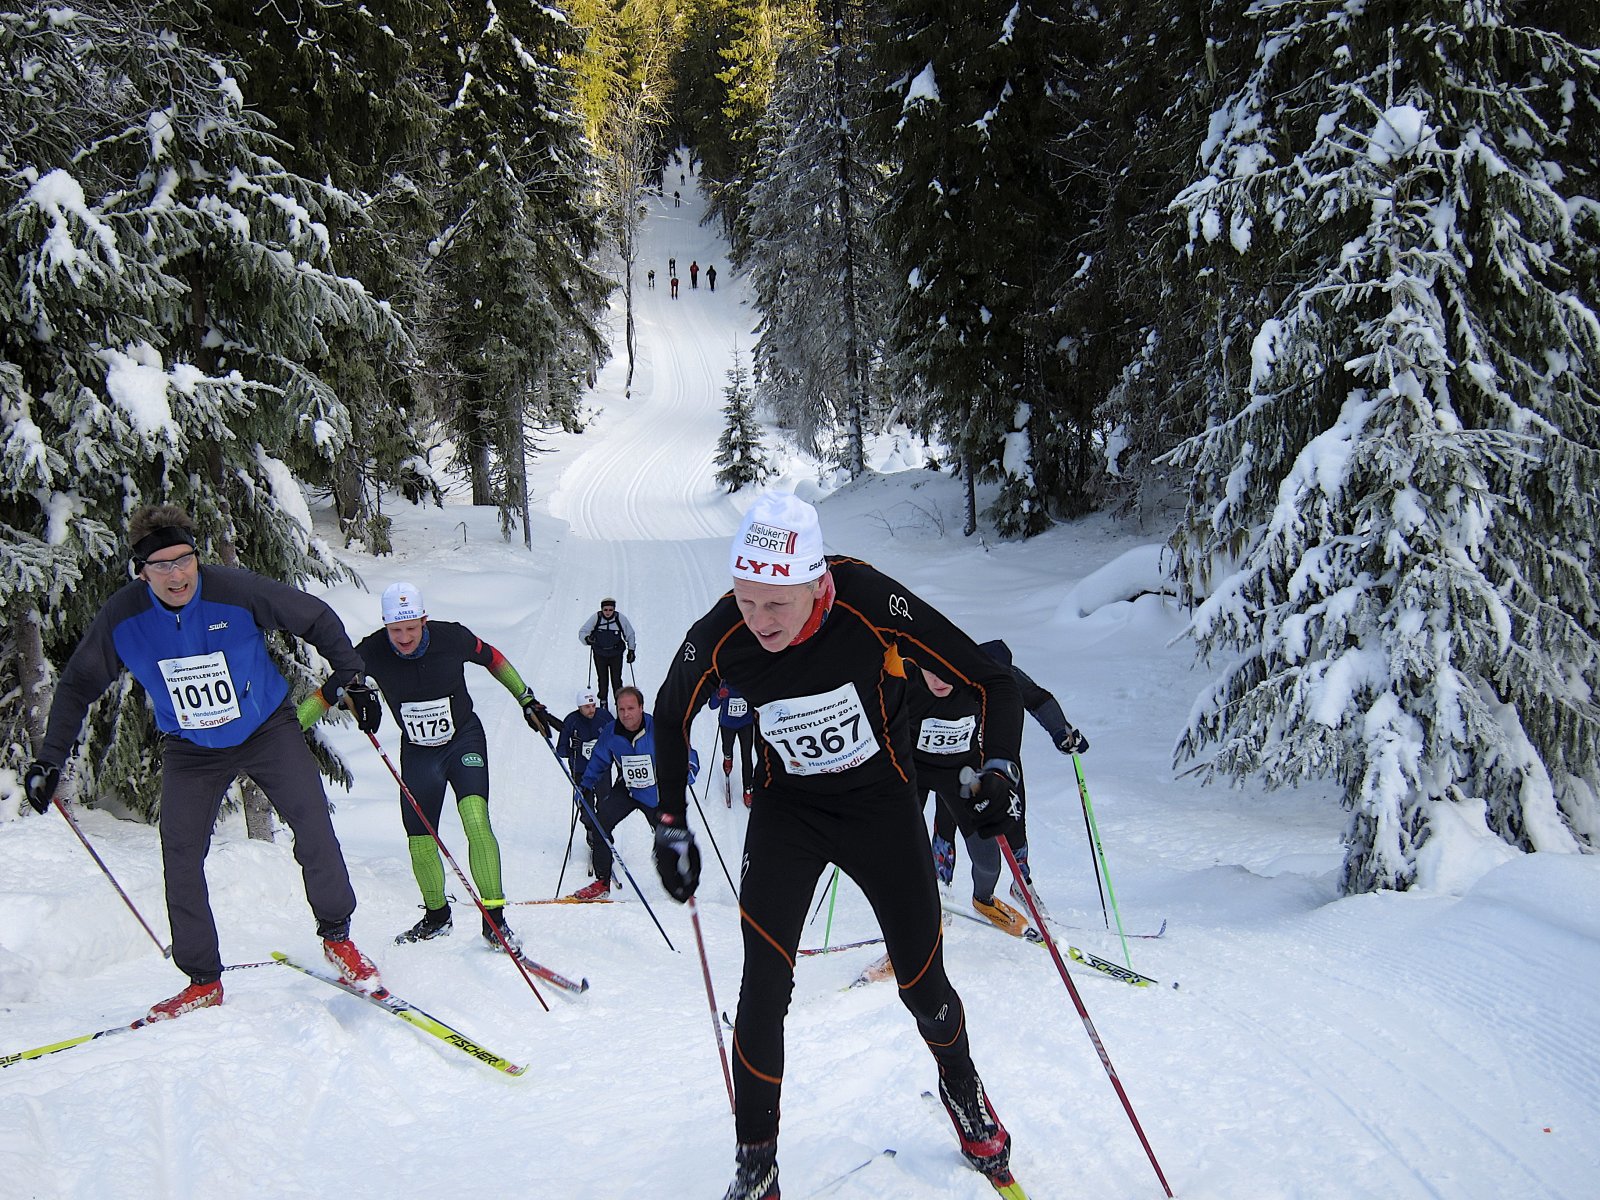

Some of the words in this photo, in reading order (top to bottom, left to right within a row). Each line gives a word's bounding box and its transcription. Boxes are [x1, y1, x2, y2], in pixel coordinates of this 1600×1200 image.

[745, 533, 786, 552] SPORT
[735, 556, 790, 577] LYN
[166, 673, 212, 683] VESTERGYLLEN
[212, 670, 226, 678] 2011
[173, 680, 232, 710] 1010
[730, 704, 746, 712] 1312
[777, 699, 849, 723] sportsmaster.no
[200, 715, 230, 728] Scandic
[408, 718, 450, 738] 1173
[764, 715, 837, 737] VESTERGYLLEN
[838, 704, 858, 718] 2011
[775, 713, 861, 759] 1367
[922, 731, 970, 747] 1354
[808, 737, 872, 767] Handelsbanken
[627, 767, 649, 779] 989
[175, 988, 218, 1017] alpina
[444, 1034, 500, 1065] FISCHER
